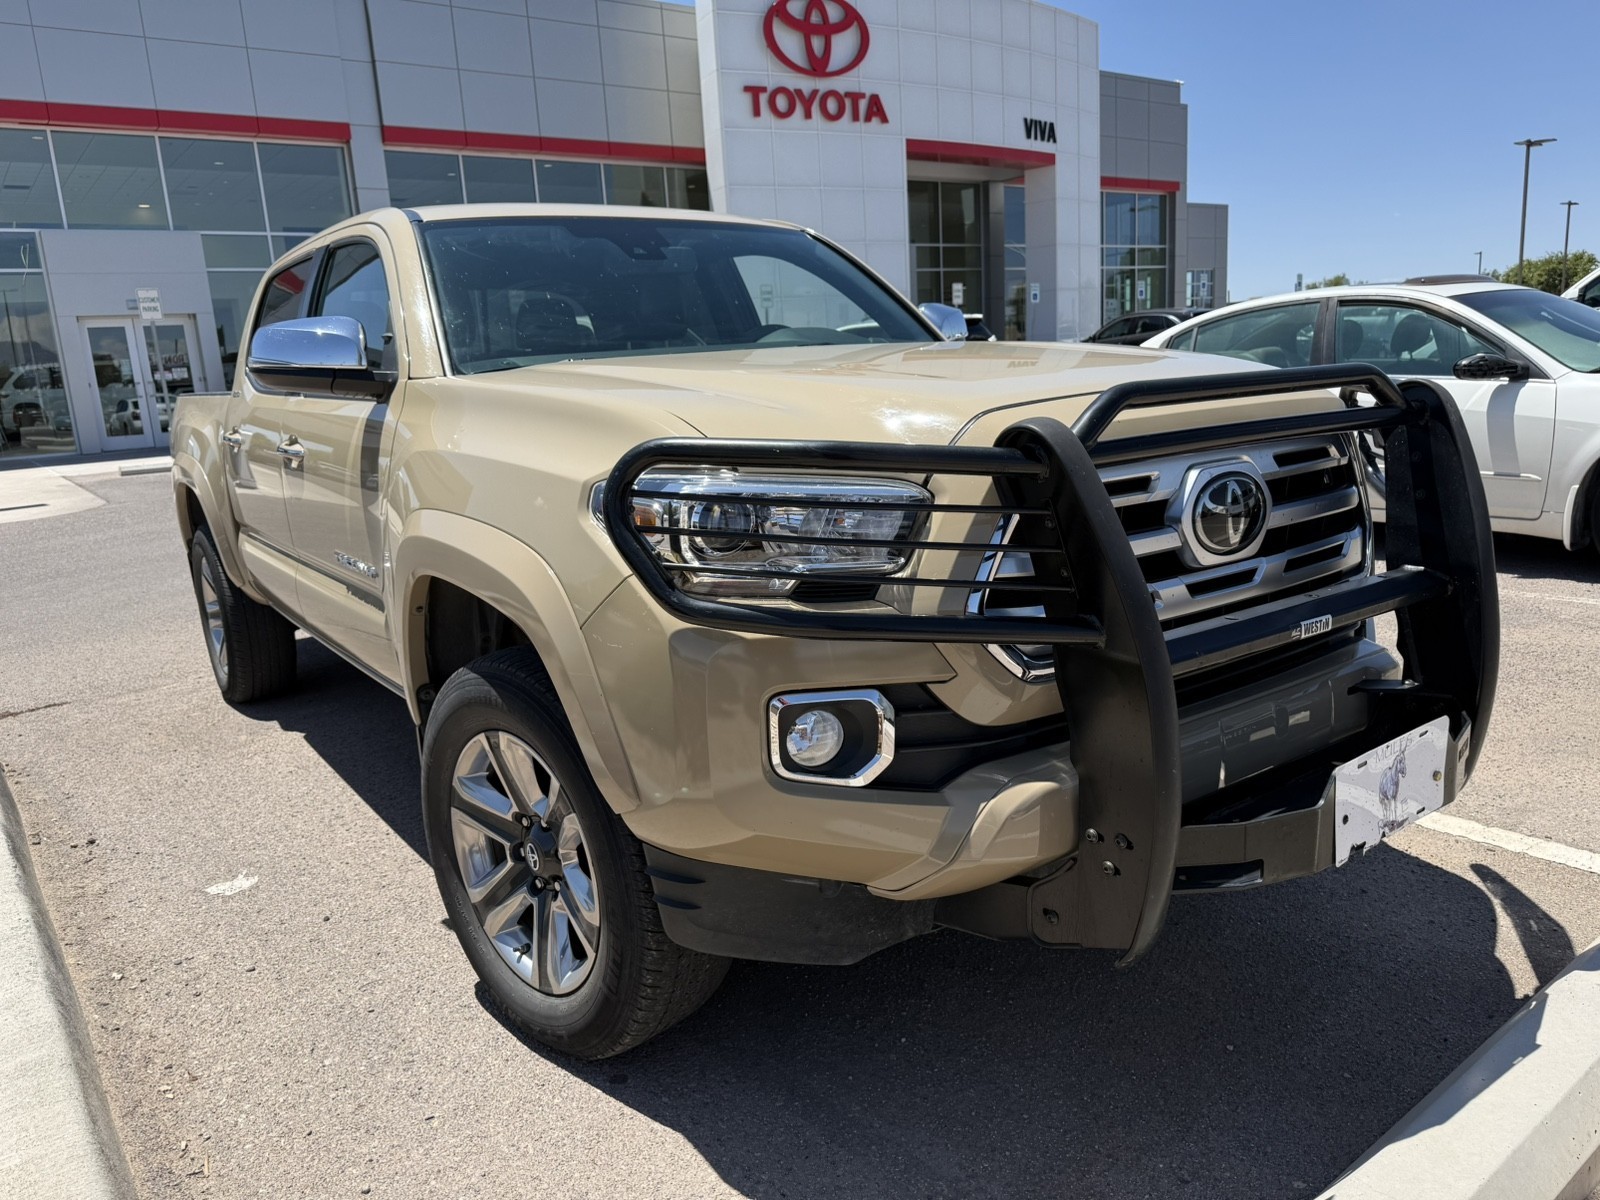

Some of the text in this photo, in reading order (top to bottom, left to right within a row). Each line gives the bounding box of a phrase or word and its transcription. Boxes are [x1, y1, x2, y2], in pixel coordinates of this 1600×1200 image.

[743, 85, 890, 124] TOYOTA
[1023, 117, 1057, 144] VIVA
[1303, 617, 1330, 636] WESTIN
